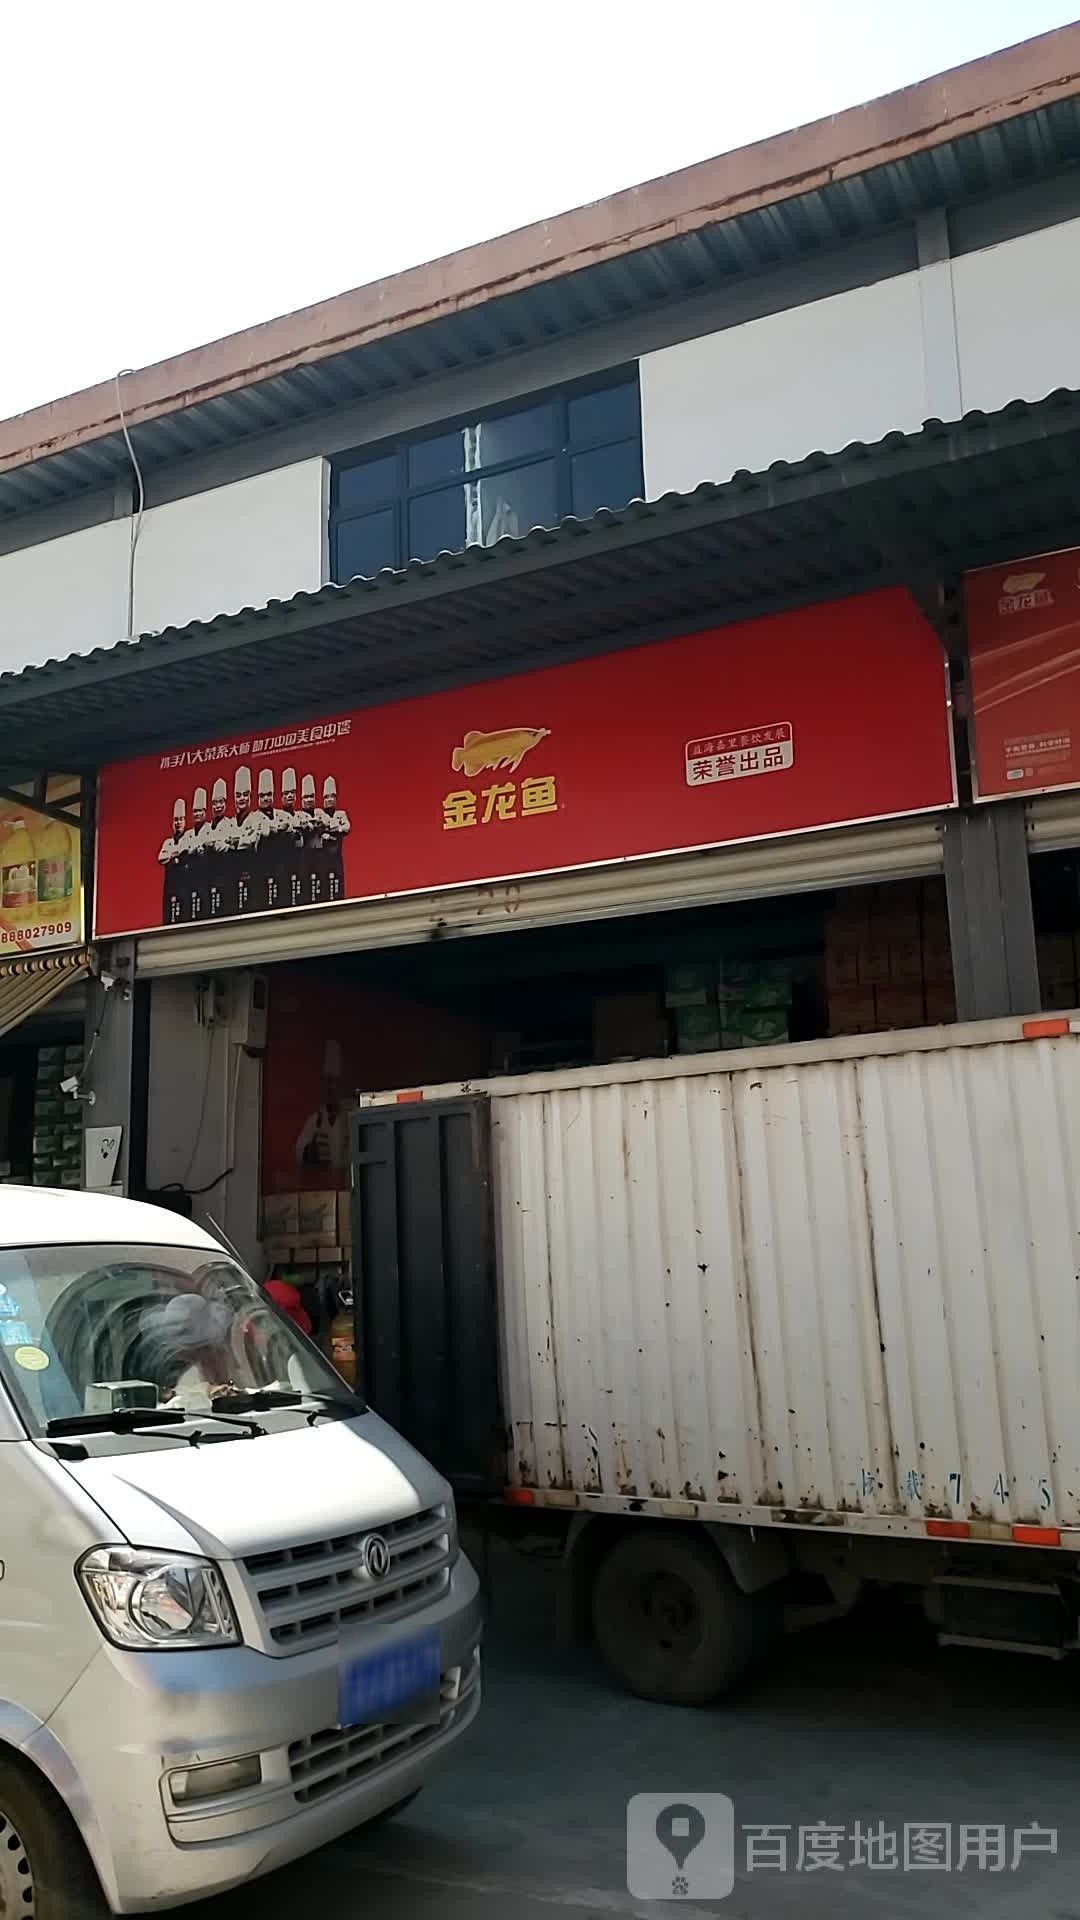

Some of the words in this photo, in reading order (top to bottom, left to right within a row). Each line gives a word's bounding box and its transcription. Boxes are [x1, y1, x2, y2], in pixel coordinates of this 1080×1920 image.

[692, 746, 784, 781] 荣誉出品
[442, 776, 558, 830] 金龙鱼
[1, 921, 73, 944] 888027909
